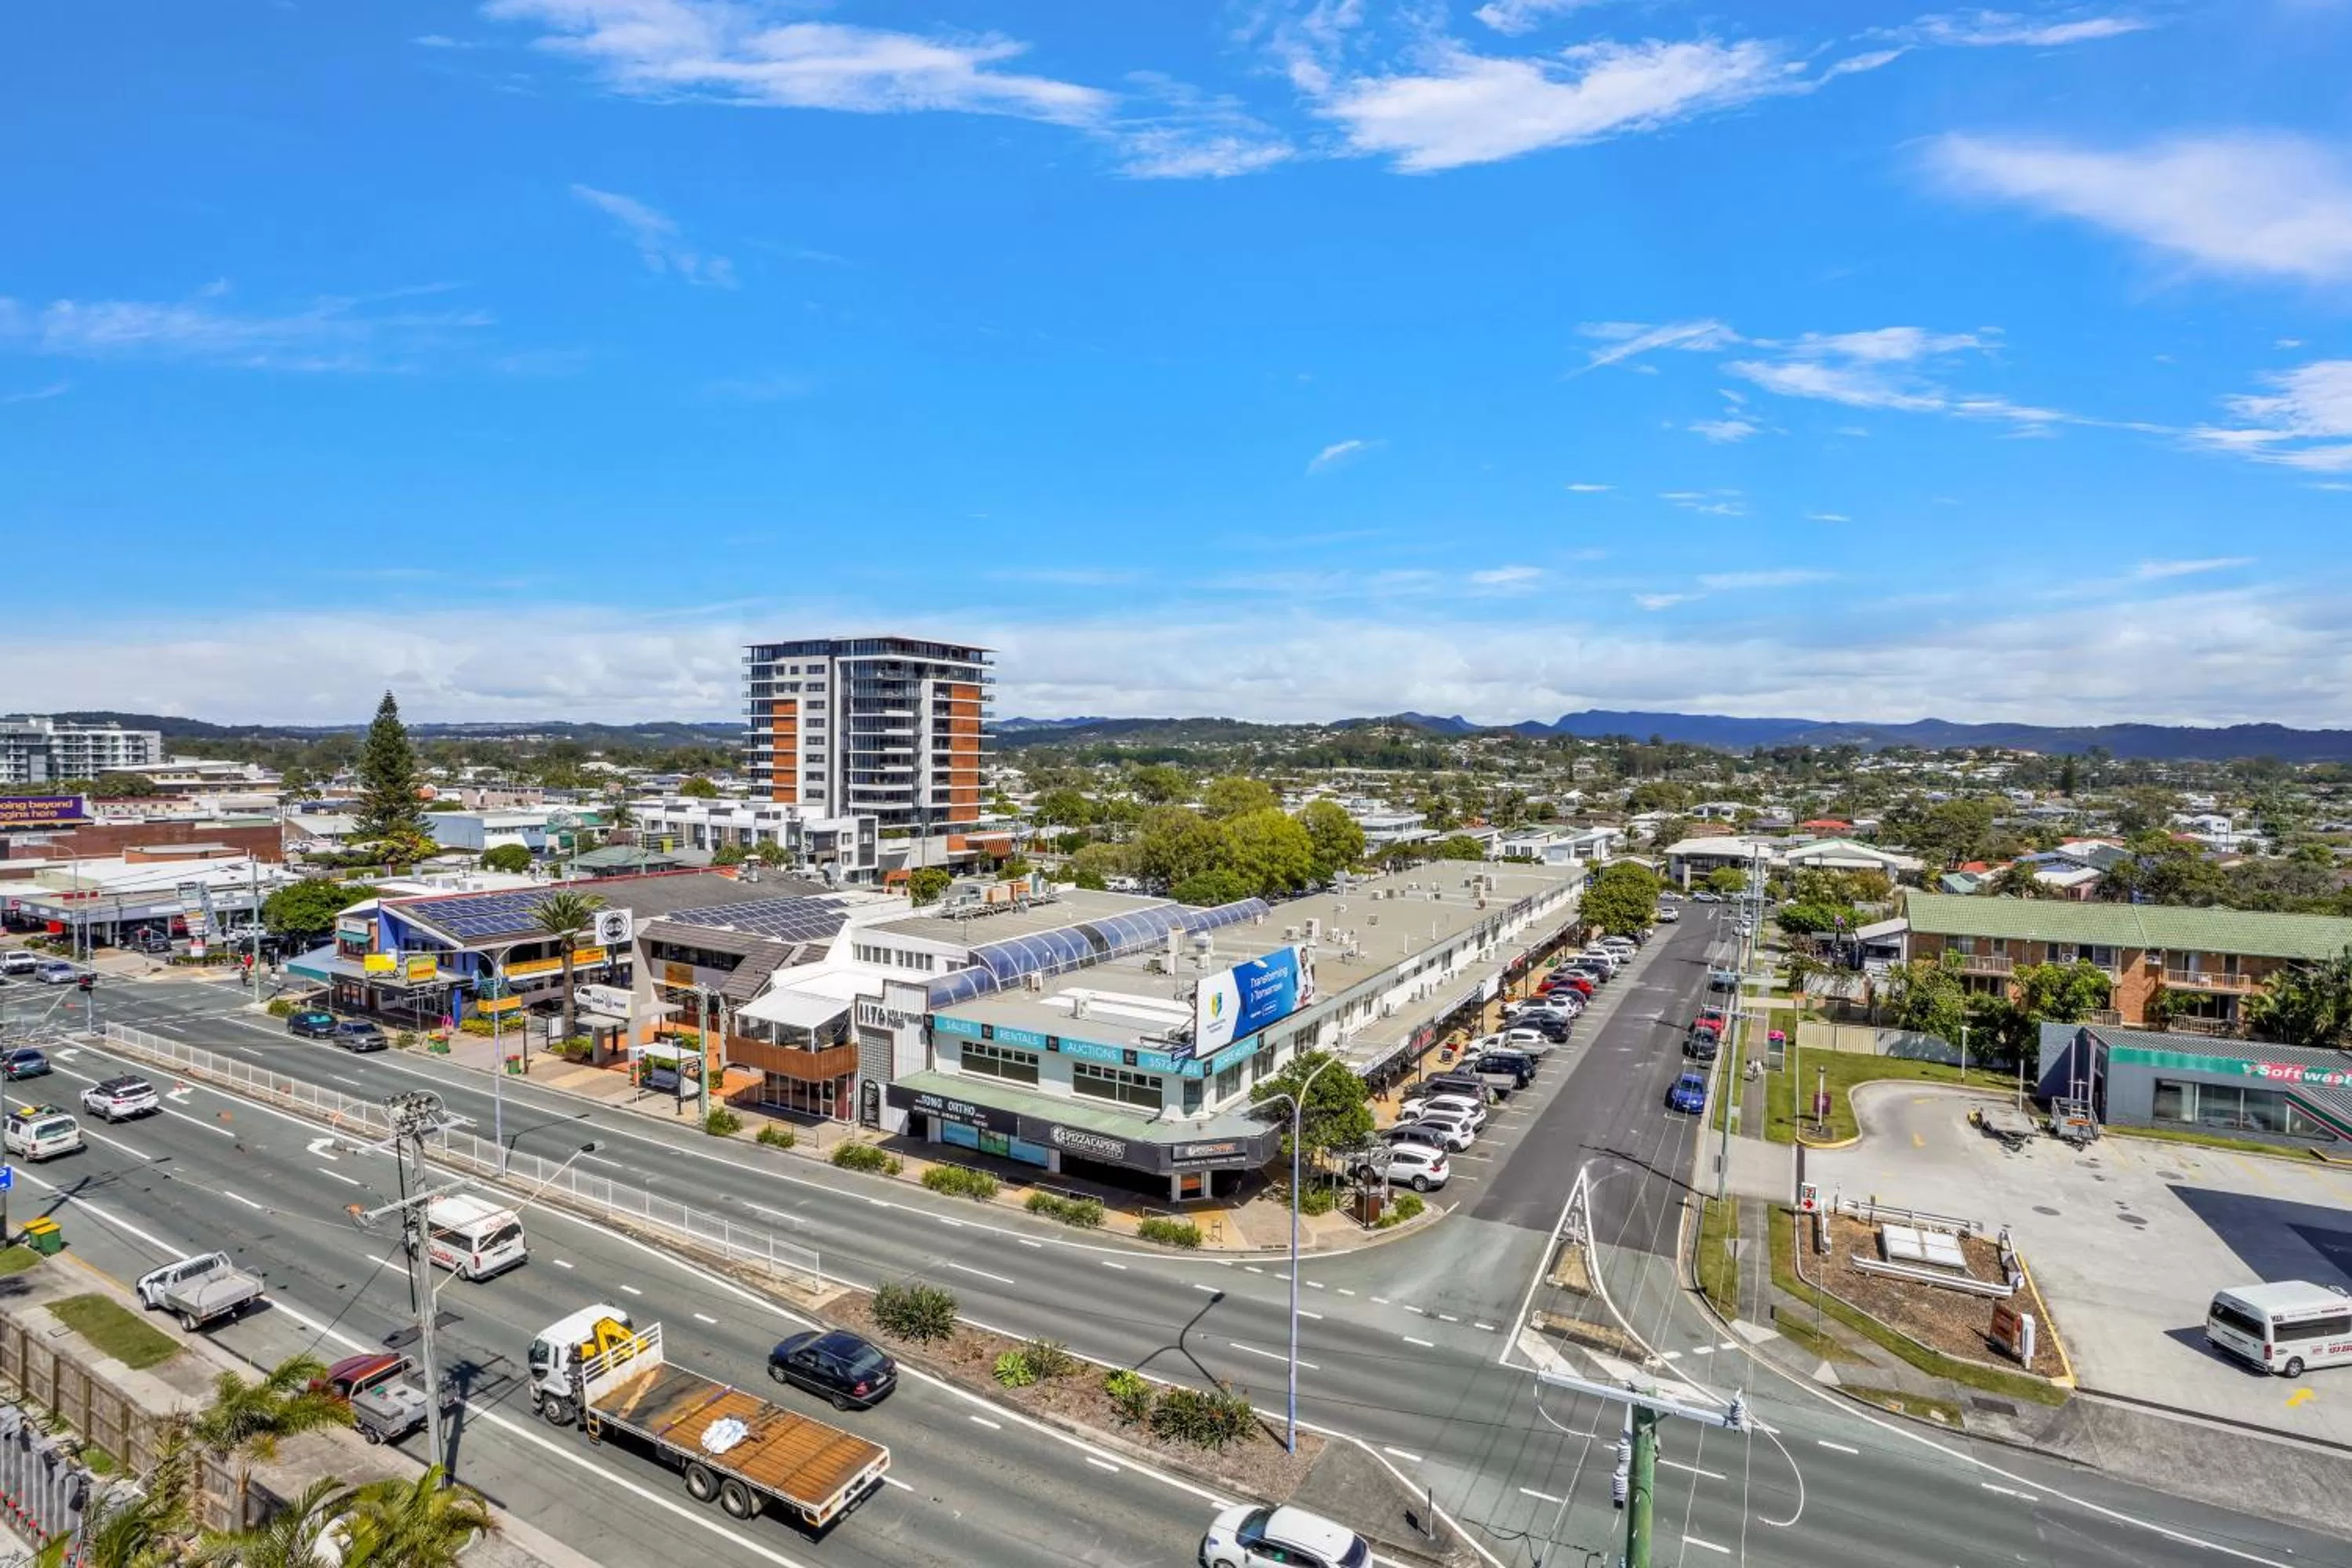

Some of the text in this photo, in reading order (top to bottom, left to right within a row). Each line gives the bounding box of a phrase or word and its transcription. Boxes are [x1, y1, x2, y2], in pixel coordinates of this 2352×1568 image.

[0, 800, 73, 811] oing beyond
[31, 808, 58, 818] here
[859, 1003, 886, 1027] 1176
[946, 1019, 972, 1033] SALES
[999, 1029, 1040, 1046] RENTALS
[1067, 1042, 1118, 1060] AUCTIONS
[947, 1101, 975, 1117] ORTHO
